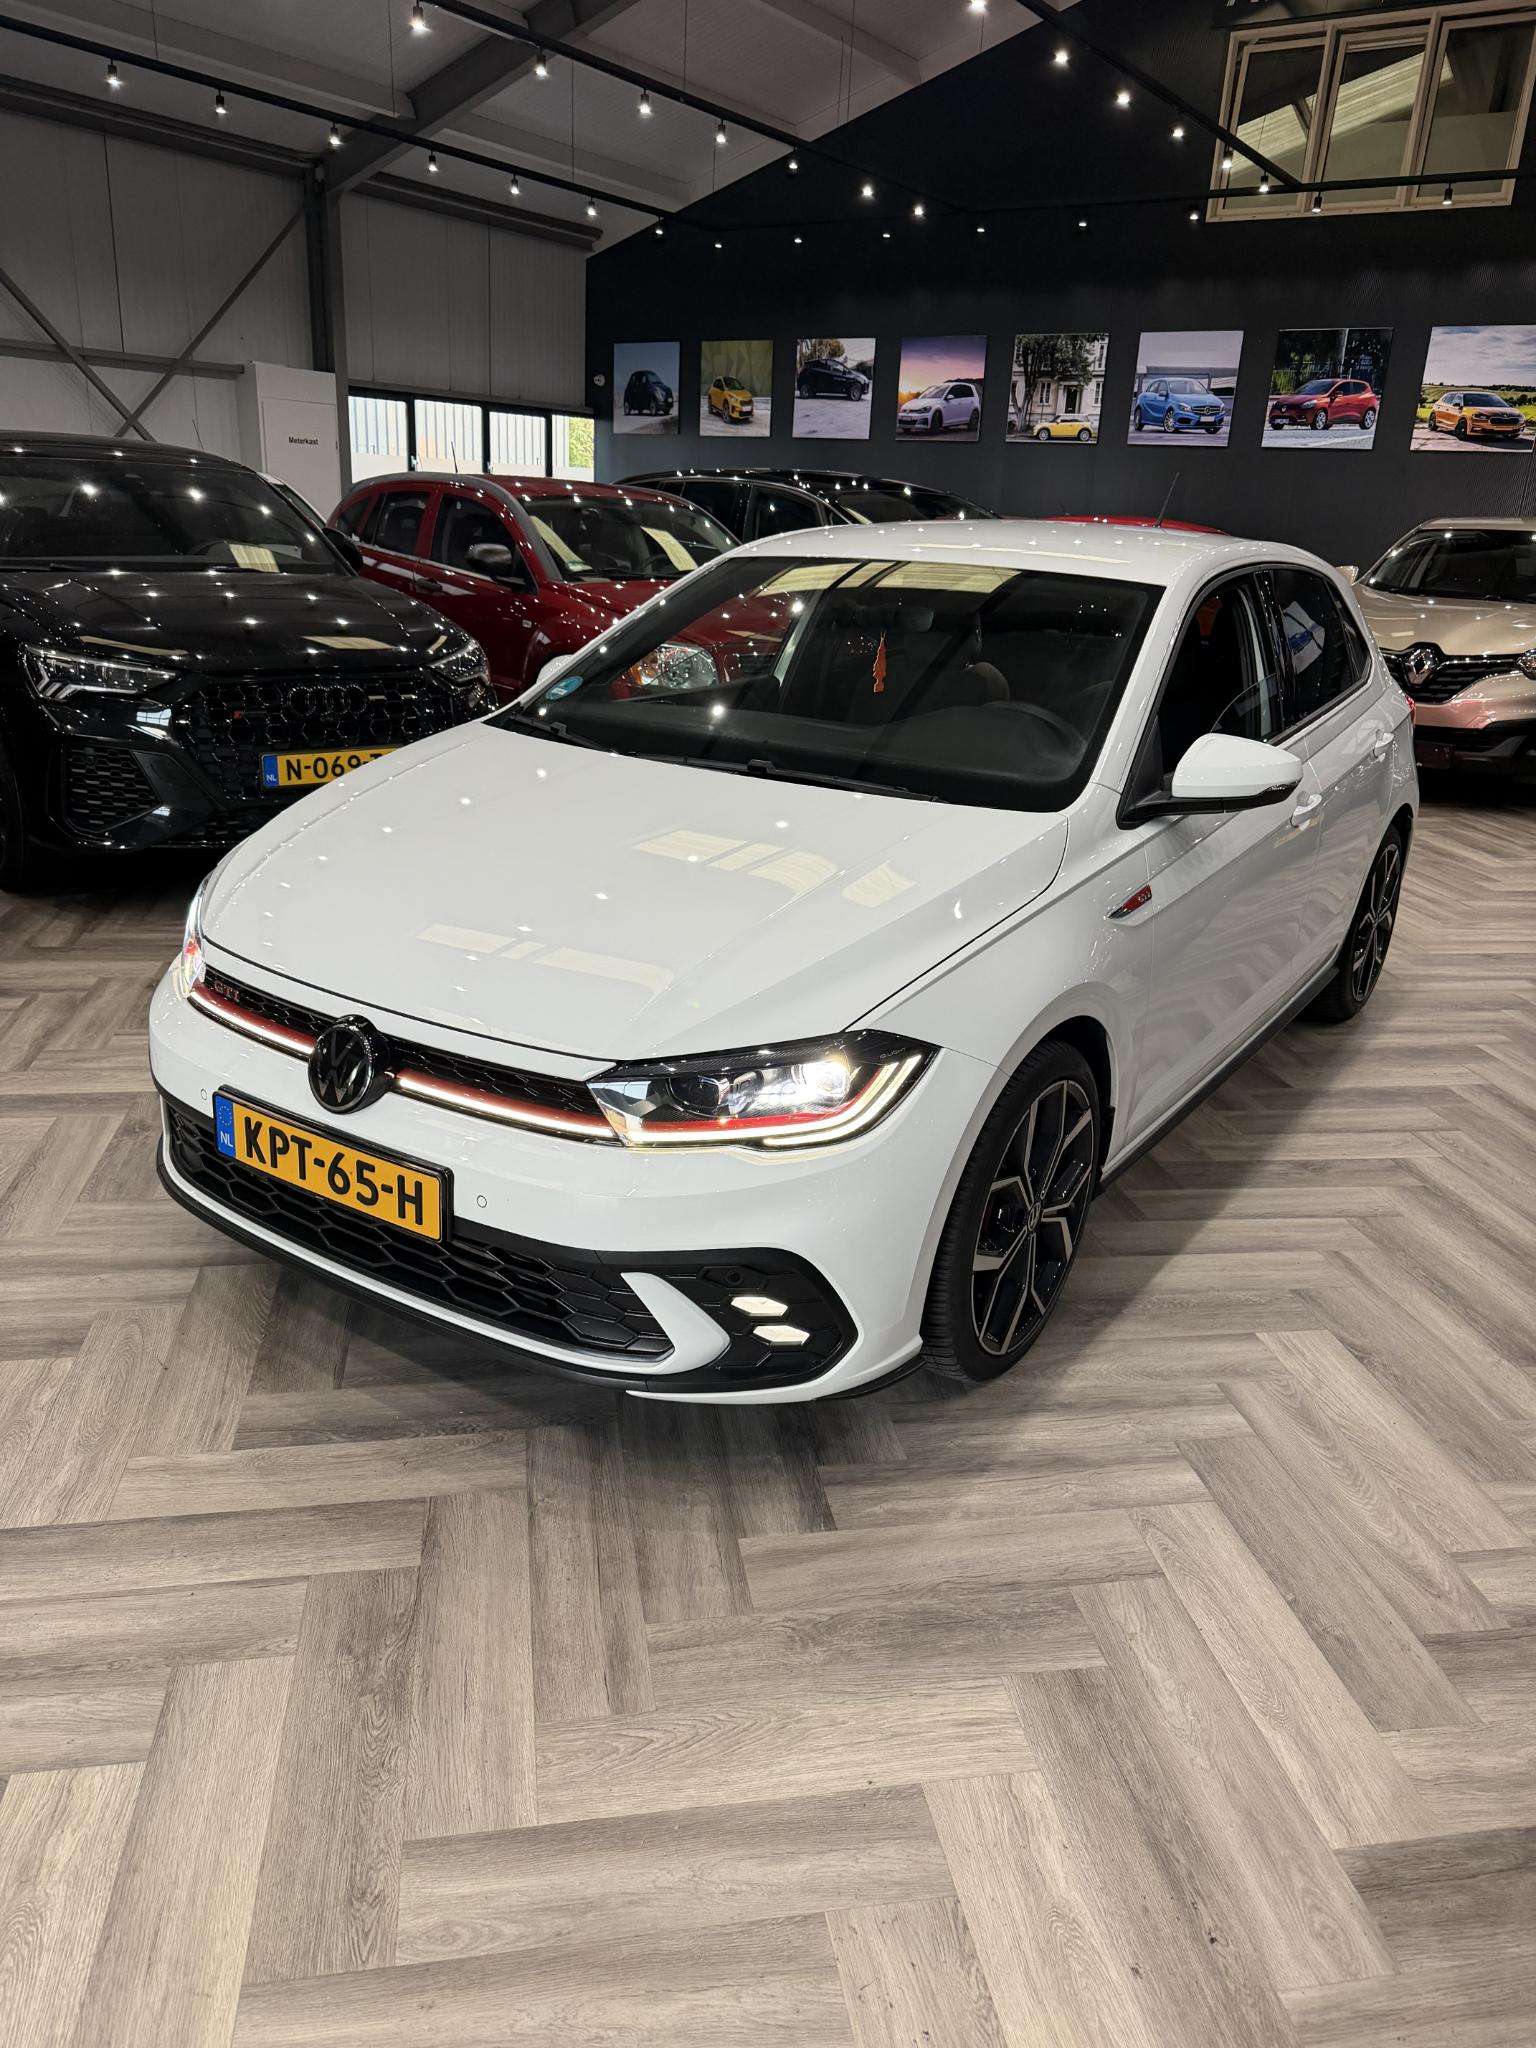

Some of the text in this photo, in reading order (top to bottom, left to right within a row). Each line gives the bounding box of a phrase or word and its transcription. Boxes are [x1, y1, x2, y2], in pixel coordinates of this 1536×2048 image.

[288, 436, 319, 445] Meterkast
[286, 753, 383, 781] N-069-
[266, 774, 277, 782] NL
[213, 980, 240, 1002] GTI
[220, 1130, 234, 1148] NL
[244, 1116, 423, 1225] KPT-65-H
